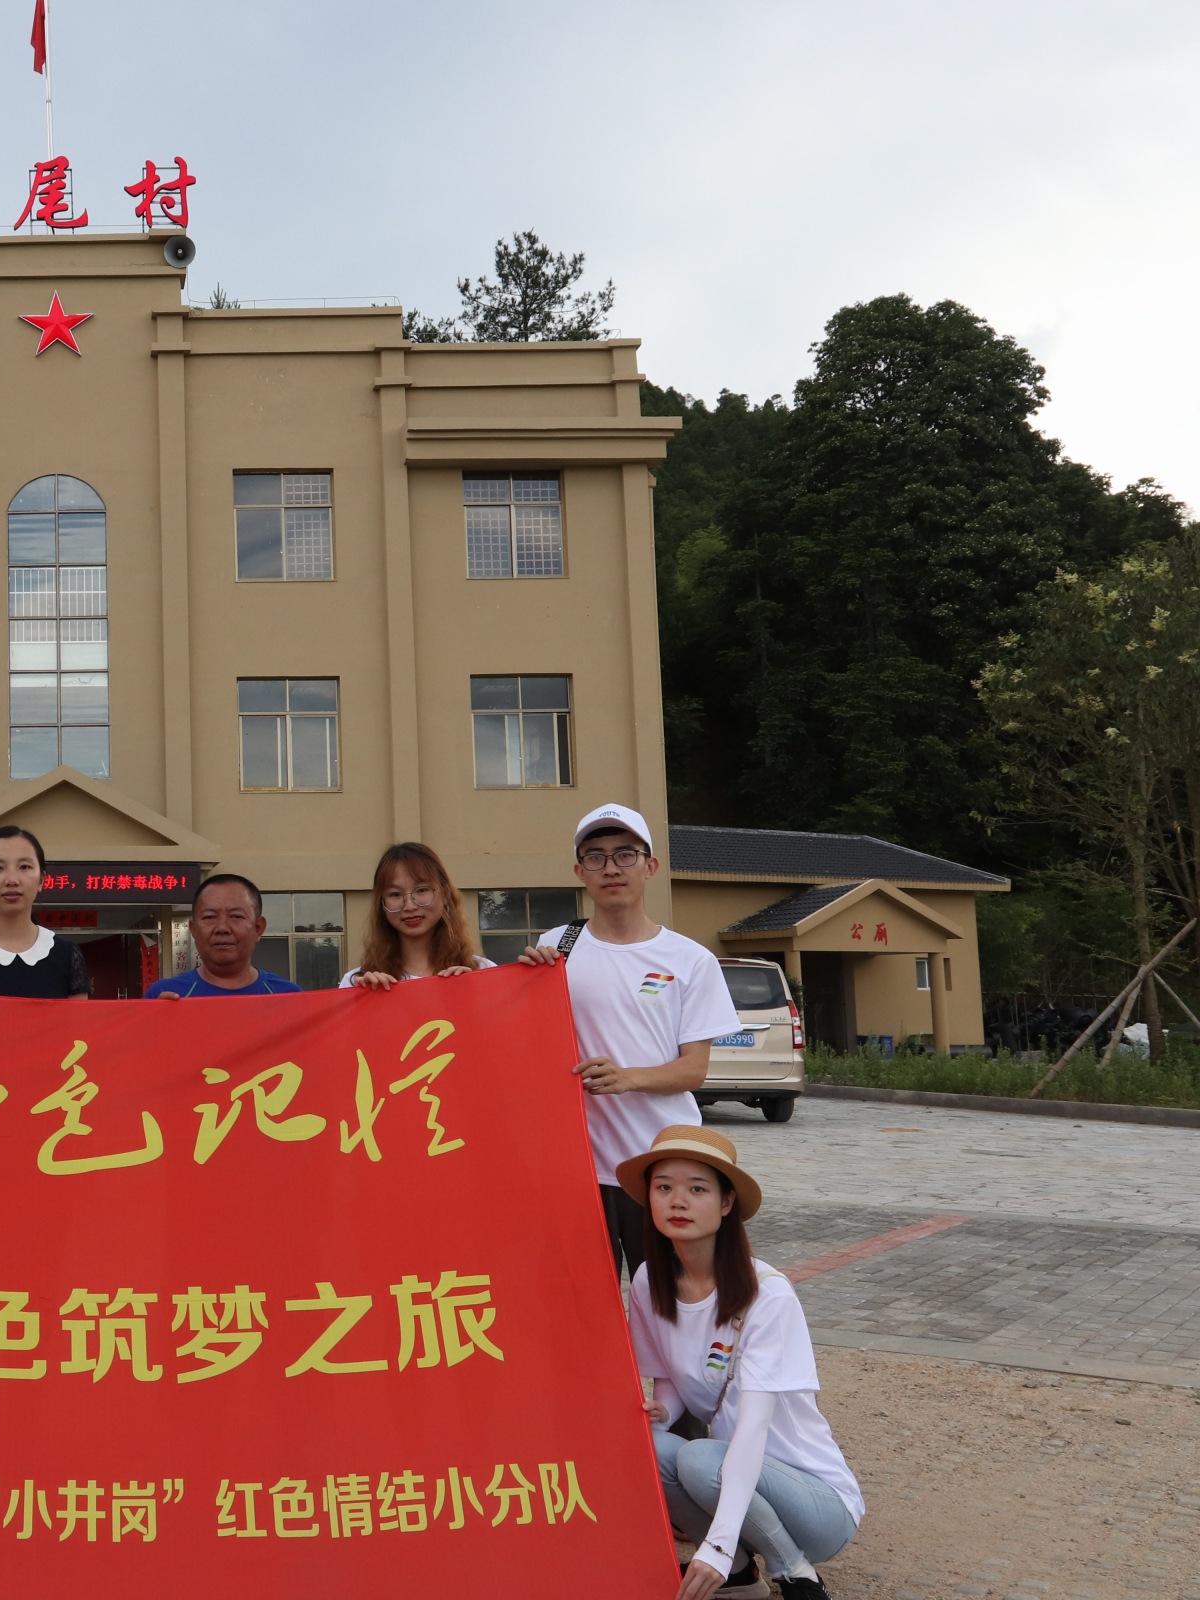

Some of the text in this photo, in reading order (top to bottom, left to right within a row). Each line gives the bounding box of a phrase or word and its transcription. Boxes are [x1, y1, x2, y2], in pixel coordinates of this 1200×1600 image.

[557, 925, 575, 952] LIMITED
[563, 926, 582, 953] EDITION
[851, 922, 888, 946] 公厕
[716, 1034, 754, 1044] 05990
[215, 1460, 598, 1539] 红色情结小分队
